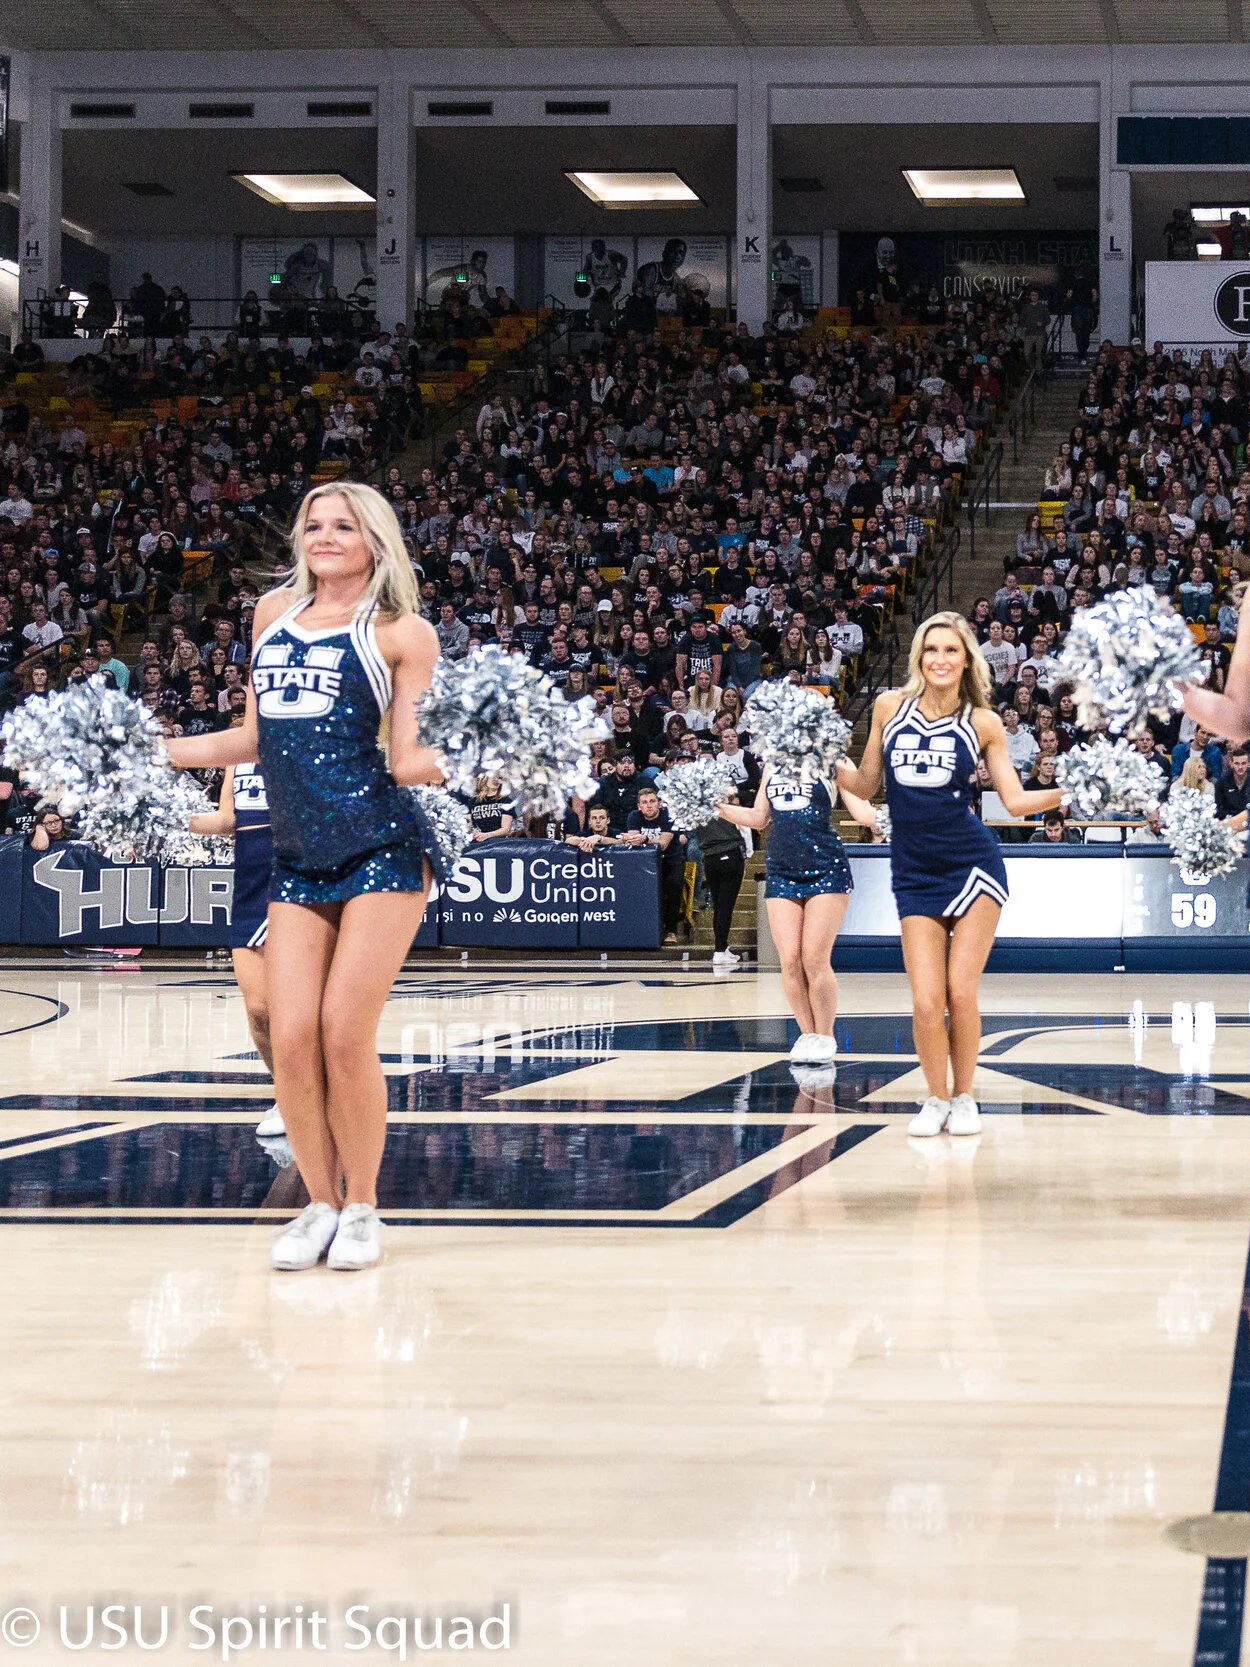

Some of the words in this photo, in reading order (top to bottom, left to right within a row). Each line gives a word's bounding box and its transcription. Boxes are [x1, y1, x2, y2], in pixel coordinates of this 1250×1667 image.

[26, 240, 39, 257] H
[385, 238, 396, 255] J
[745, 236, 760, 253] K
[943, 240, 1026, 266] UTAH
[1109, 235, 1122, 252] L
[252, 665, 343, 698] STATE
[890, 749, 957, 773] STATE
[766, 784, 813, 799] STATE
[529, 857, 615, 880] Credit
[530, 882, 616, 903] Union
[1171, 892, 1217, 928] 59
